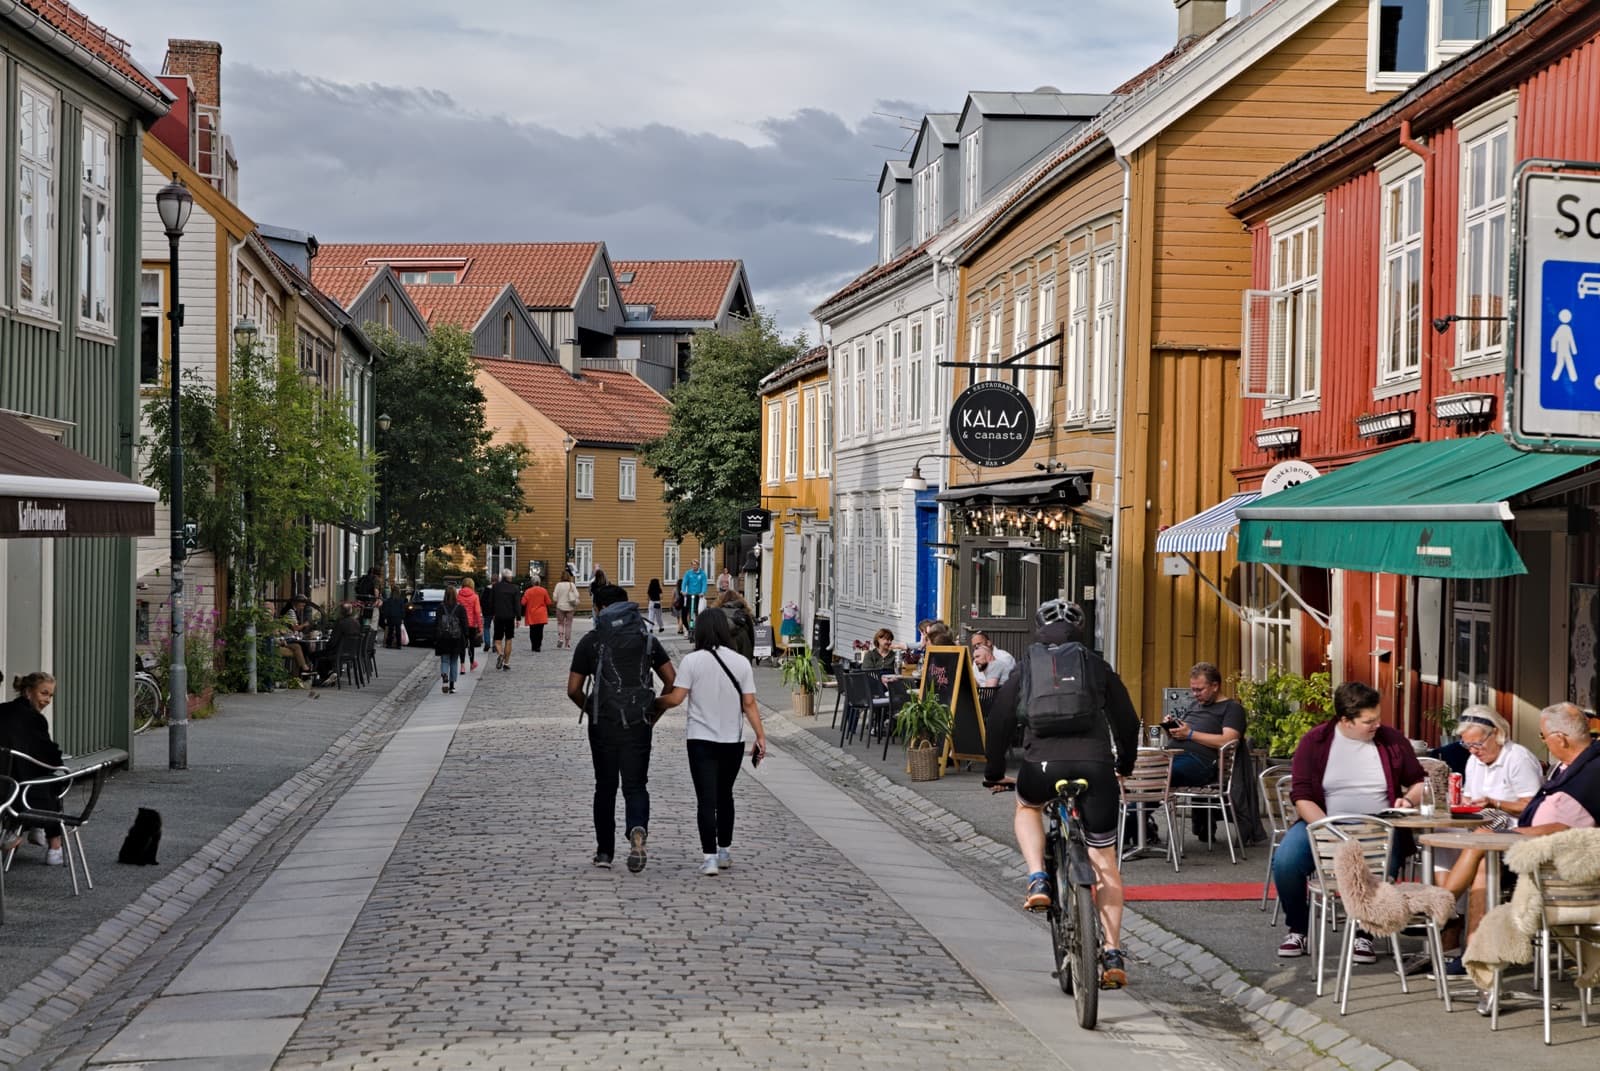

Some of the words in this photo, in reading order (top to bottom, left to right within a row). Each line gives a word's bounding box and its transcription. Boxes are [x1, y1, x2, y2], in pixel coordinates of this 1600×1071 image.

[972, 382, 1015, 392] RESTAURANT
[963, 408, 1023, 428] KALAS
[962, 430, 968, 439] &
[974, 431, 1023, 440] canasta
